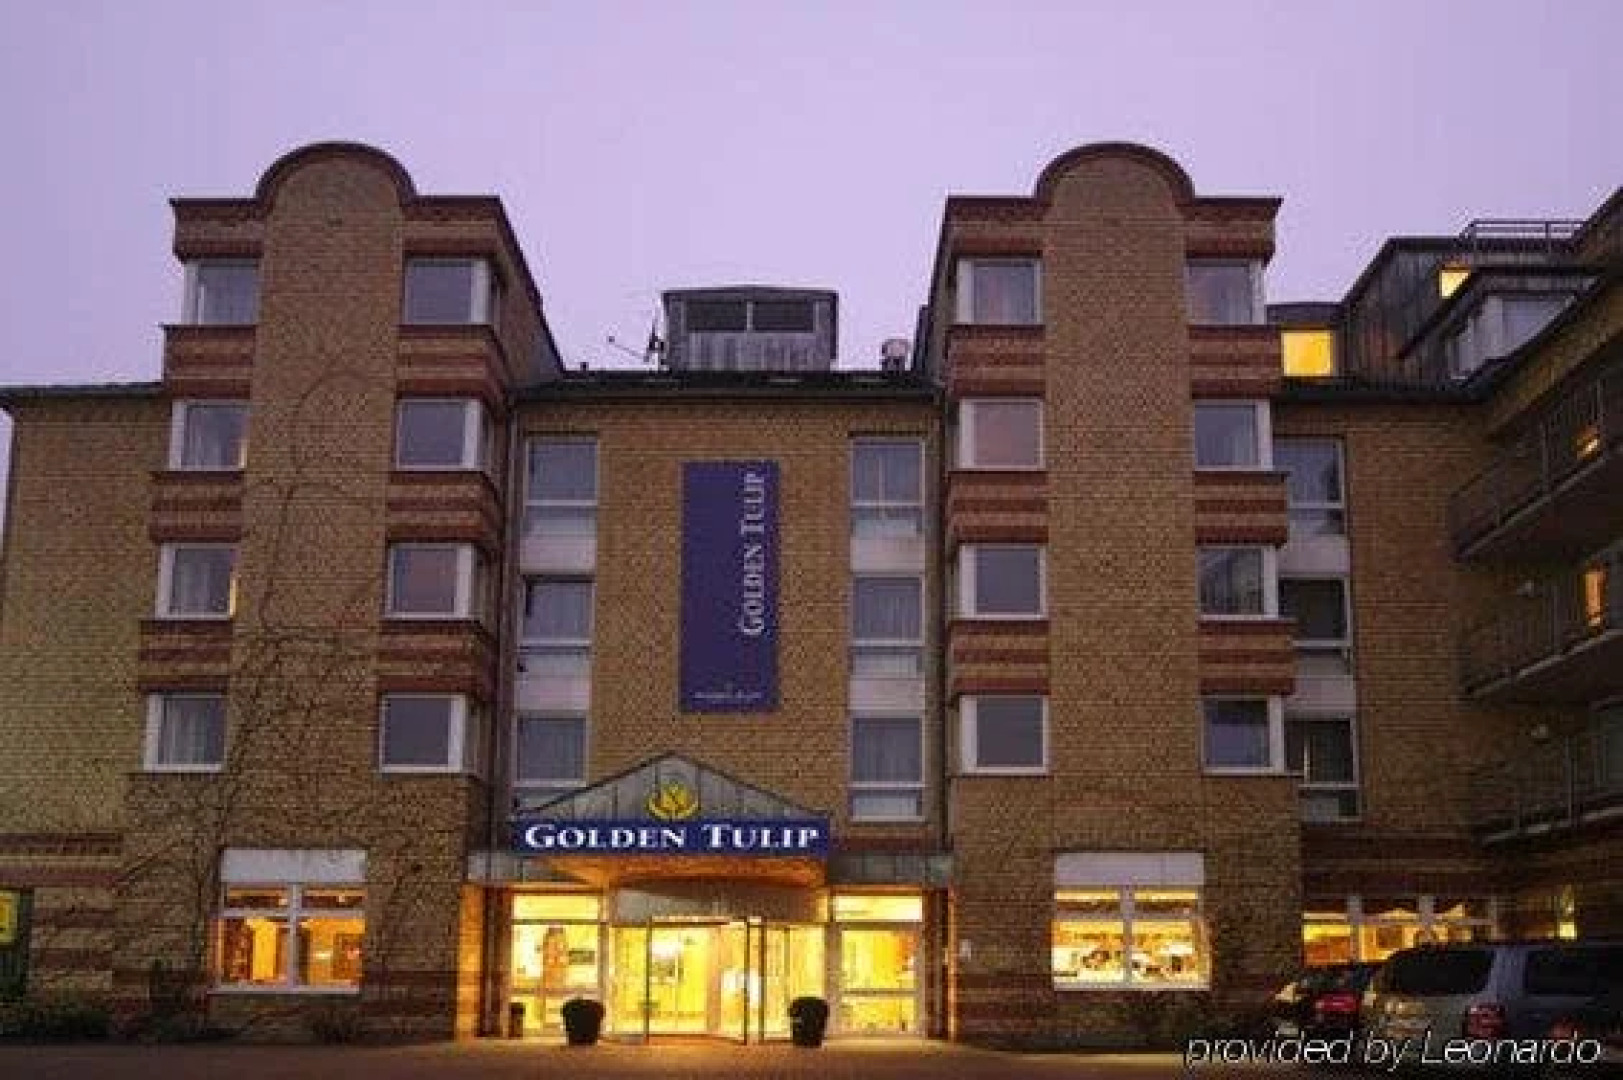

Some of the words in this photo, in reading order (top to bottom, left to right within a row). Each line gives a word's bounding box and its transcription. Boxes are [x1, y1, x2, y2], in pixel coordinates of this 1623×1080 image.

[740, 472, 765, 535] TULIP
[740, 545, 765, 635] GOLDEN
[524, 823, 688, 849] GOLDEN
[701, 823, 820, 849] TULIP
